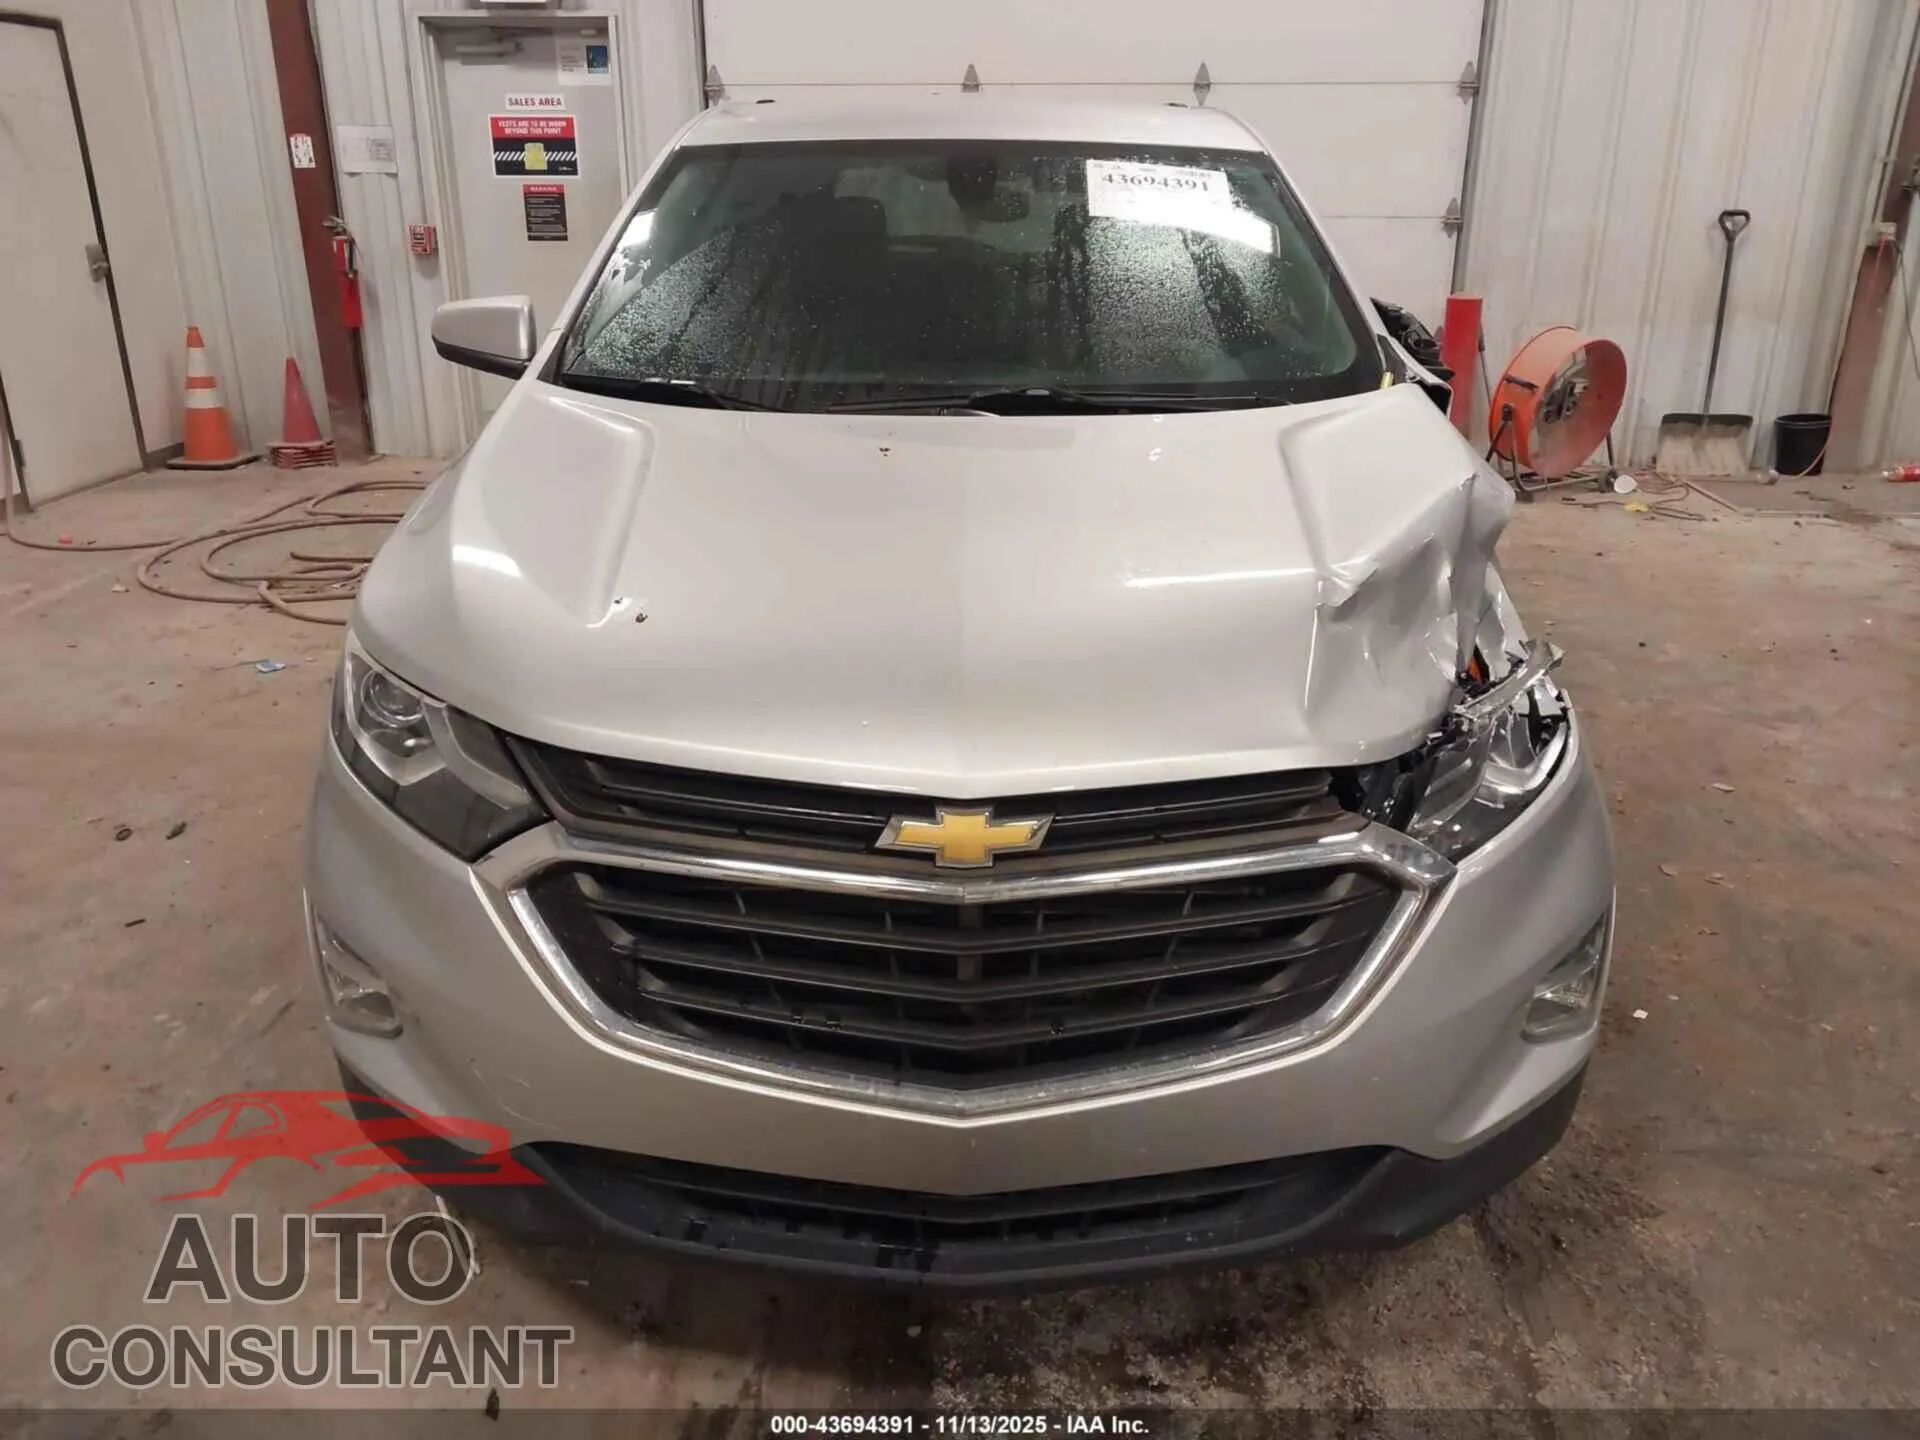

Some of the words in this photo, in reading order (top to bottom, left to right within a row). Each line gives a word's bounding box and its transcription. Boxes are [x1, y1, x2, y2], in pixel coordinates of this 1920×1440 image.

[507, 97, 536, 106] SALES
[538, 97, 562, 106] AREA
[1102, 173, 1209, 192] 43694391
